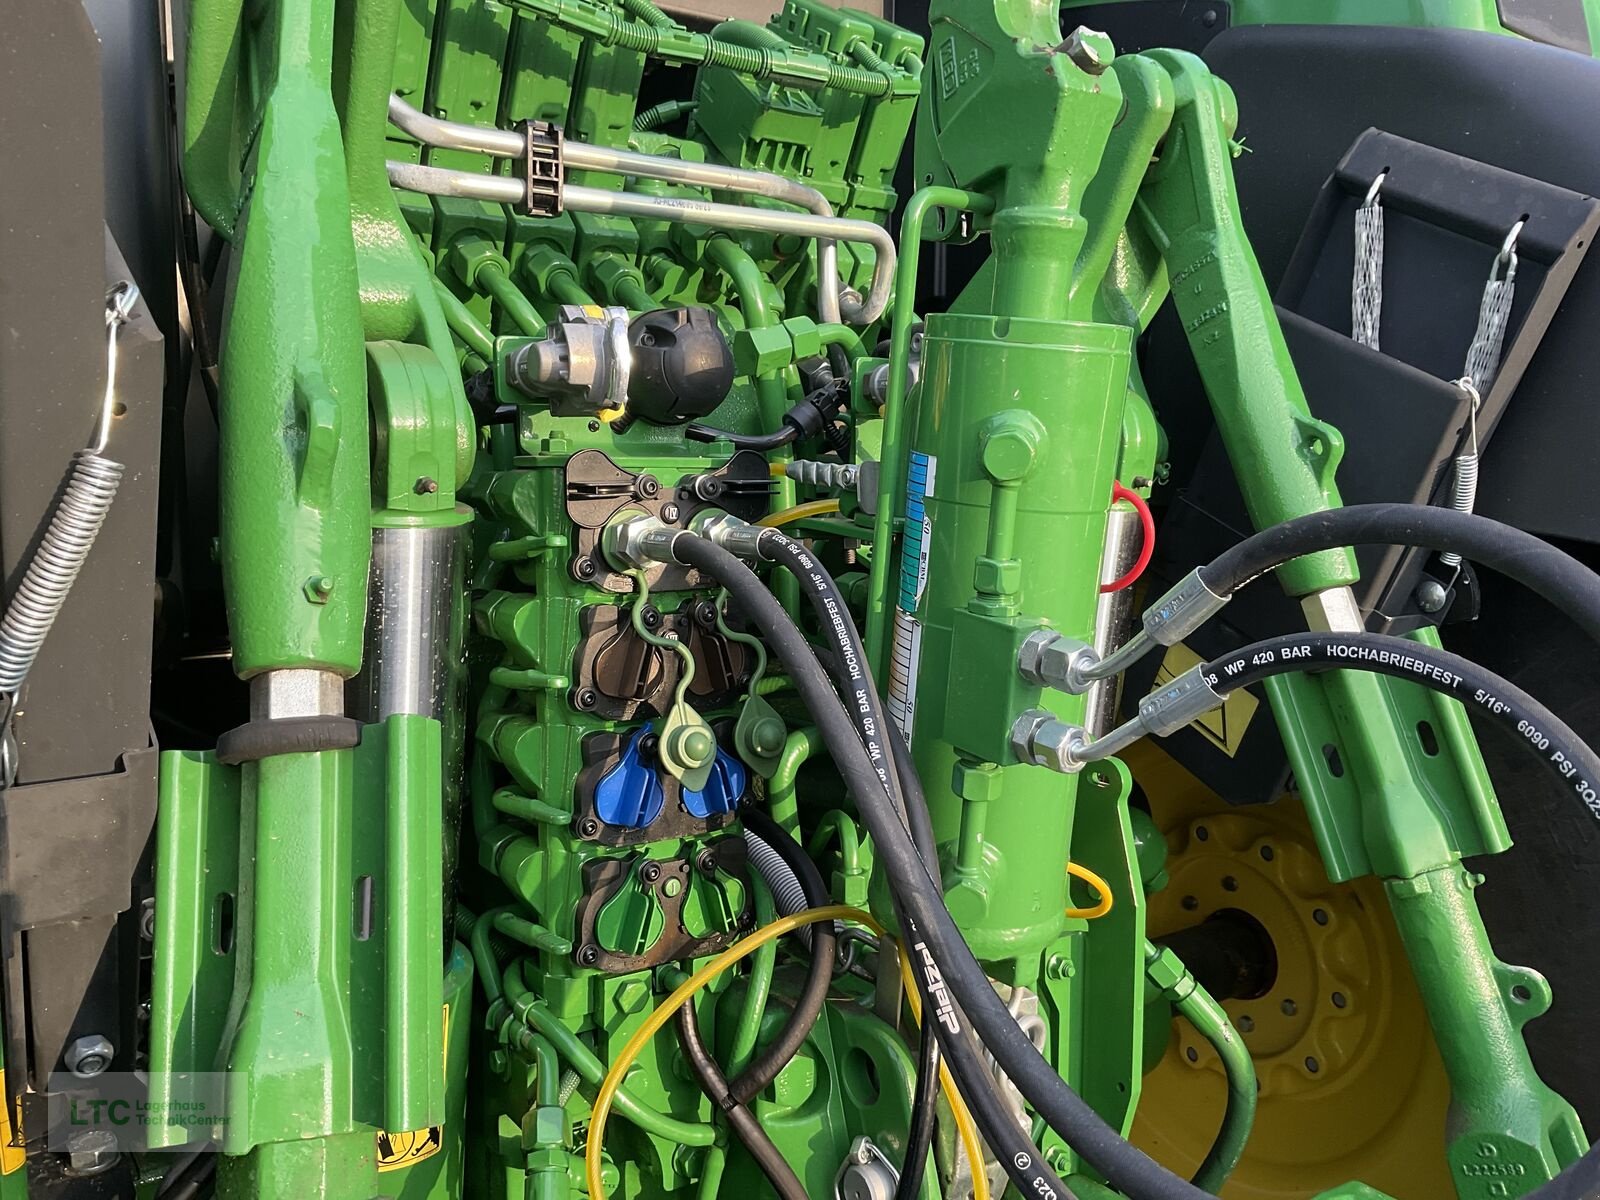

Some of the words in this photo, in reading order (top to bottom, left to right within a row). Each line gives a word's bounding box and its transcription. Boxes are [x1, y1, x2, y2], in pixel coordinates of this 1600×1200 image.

[787, 543, 801, 554] PSI
[797, 554, 814, 569] 6090
[823, 597, 862, 681] HOCHABRIEBFEST
[856, 689, 870, 713] BAR
[1224, 659, 1246, 676] WP
[1252, 651, 1275, 666] 420
[1281, 645, 1311, 660] BAR
[1326, 645, 1463, 689] HOCHABRIEBFEST
[1473, 688, 1511, 714] 5/16"
[1517, 719, 1550, 750] 6090
[1550, 751, 1577, 778] PSI
[863, 717, 875, 736] 420
[869, 742, 881, 761] WP
[914, 941, 960, 1035] dietzel
